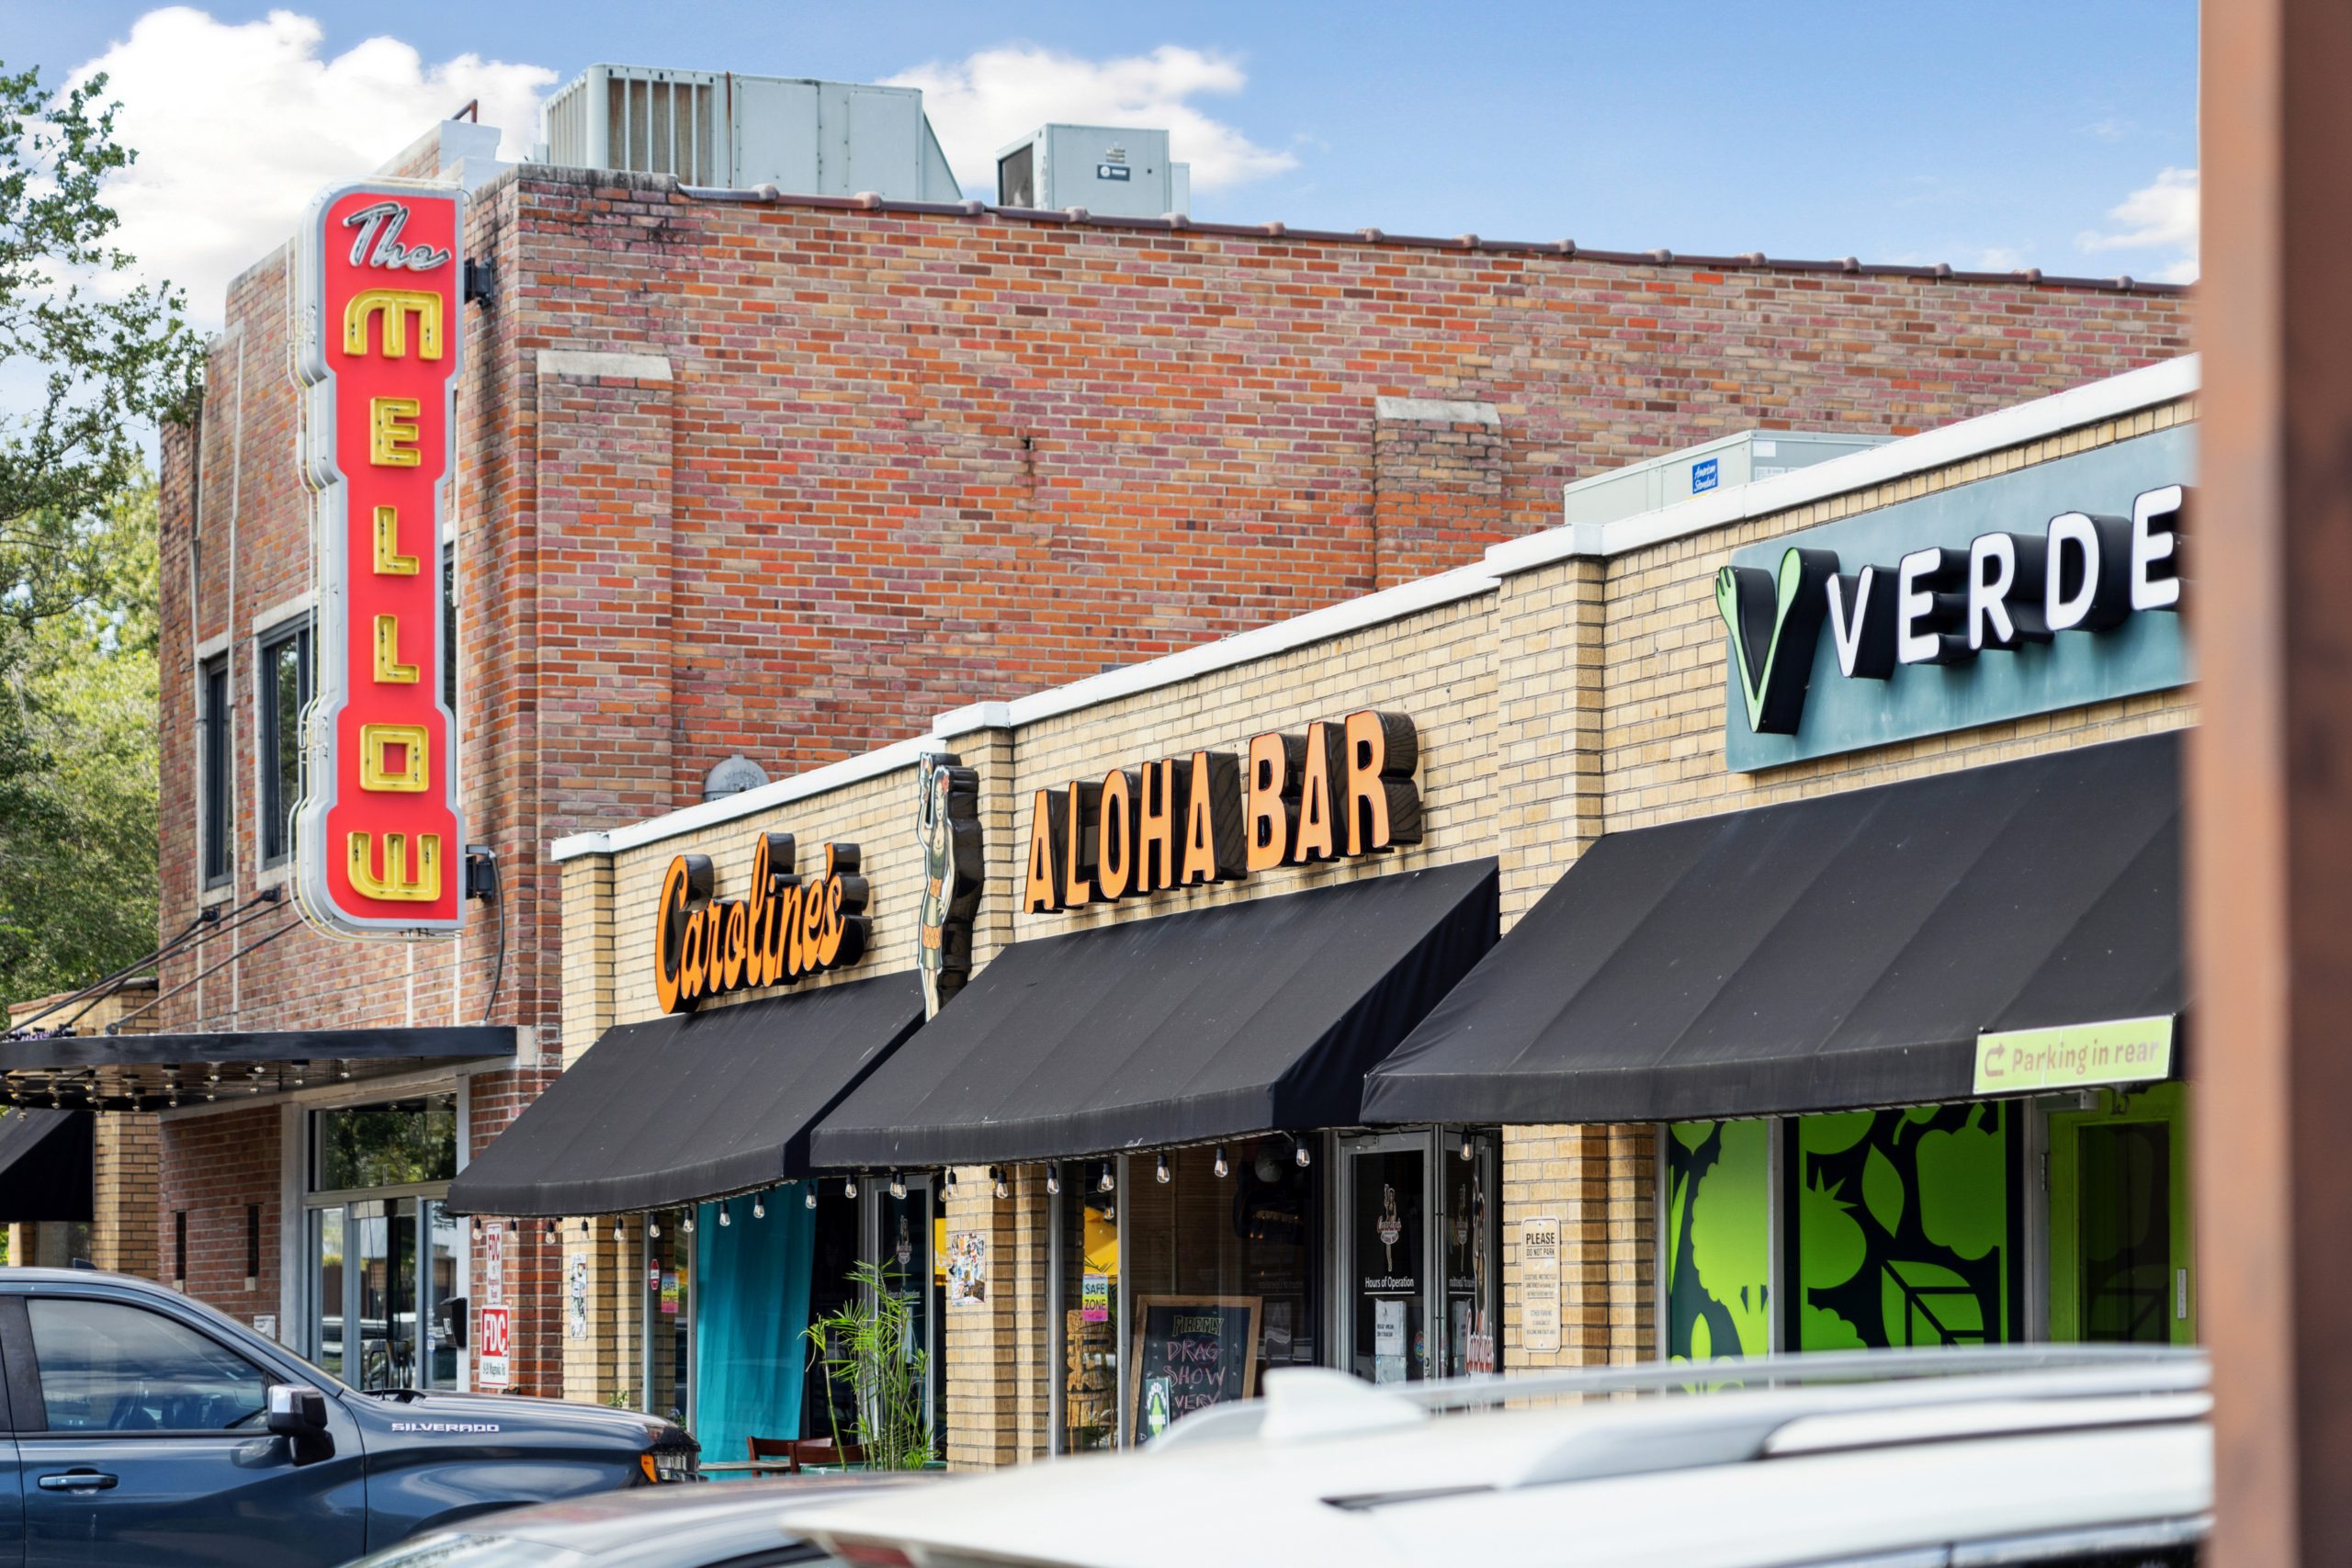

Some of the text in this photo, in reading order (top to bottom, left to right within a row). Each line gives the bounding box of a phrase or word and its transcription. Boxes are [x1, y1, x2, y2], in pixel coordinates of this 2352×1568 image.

[342, 202, 451, 271] The
[1694, 464, 1717, 479] American
[1694, 473, 1717, 491] Standard
[1826, 484, 2183, 678] VERDE
[343, 288, 443, 902] MELLOW
[1024, 709, 1391, 915] ALOHA BAR
[656, 831, 850, 1014] Caroline's
[2012, 1038, 2159, 1075] Parking in rear
[488, 1234, 500, 1261] FDC
[1526, 1232, 1555, 1245] PLEASE
[1526, 1247, 1555, 1257] DO NOT PARK
[1085, 1283, 1105, 1294] SAFE
[1364, 1276, 1415, 1290] Hours of Operation
[1084, 1299, 1106, 1311] ZONE
[483, 1313, 506, 1353] FDC
[1172, 1315, 1225, 1337] FIREFLY
[1167, 1338, 1225, 1363] DRAG
[1162, 1366, 1226, 1388] SHOW
[1171, 1387, 1221, 1411] VERY
[391, 1422, 500, 1433] SILVERADO
